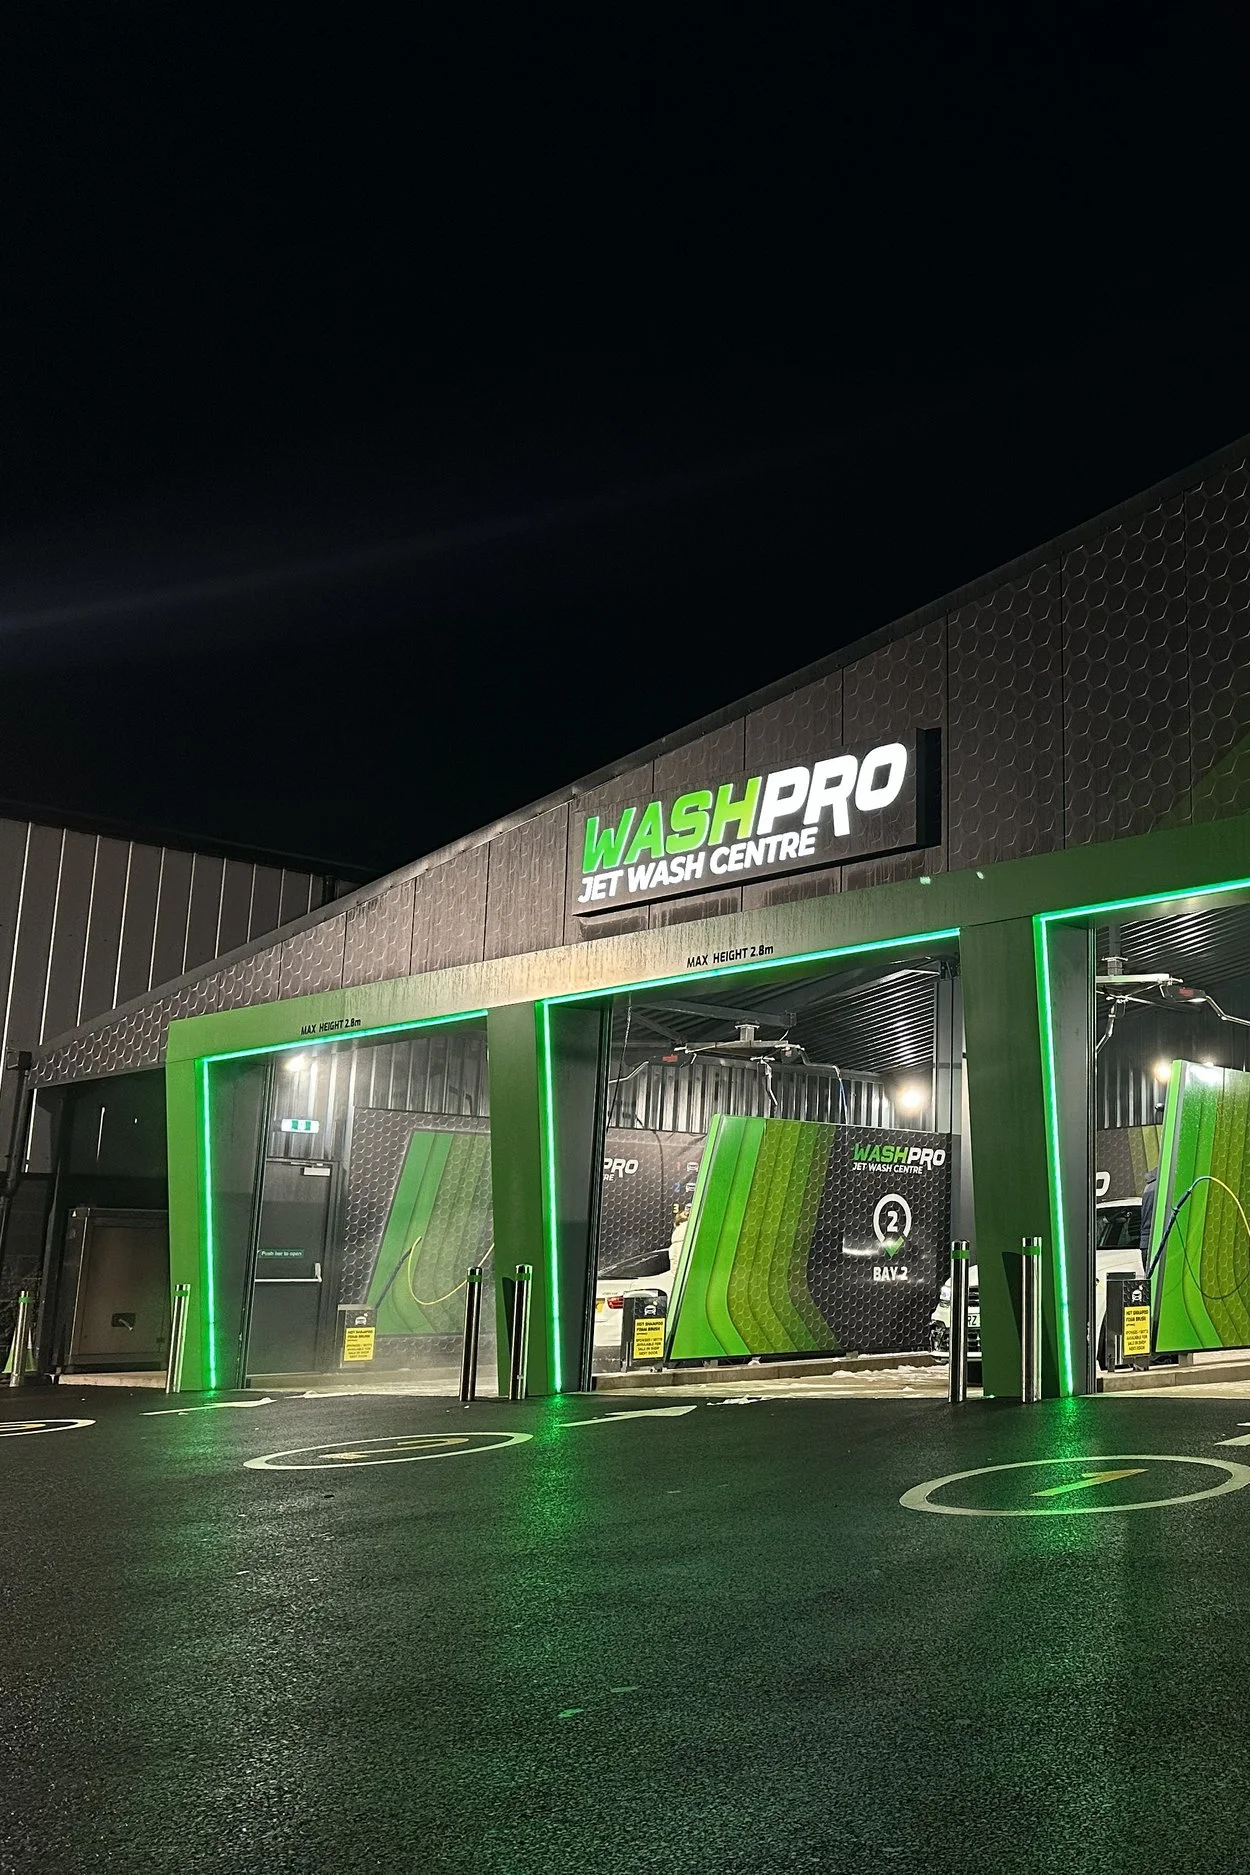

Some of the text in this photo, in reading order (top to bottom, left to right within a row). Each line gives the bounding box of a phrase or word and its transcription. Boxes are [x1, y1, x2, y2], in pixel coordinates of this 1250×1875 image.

[582, 742, 908, 874] WASHPRO
[577, 826, 819, 903] JET WASH CENTRE
[687, 944, 774, 968] MAX HEIGHT 2.8m
[301, 1017, 362, 1035] MAX HEIGHT 2.8m
[852, 1162, 924, 1174] JET WASH CENTRE
[853, 1143, 946, 1171] WASHPRO
[673, 1203, 680, 1213] 3
[886, 1210, 898, 1232] 2
[873, 1266, 908, 1281] BAY 2
